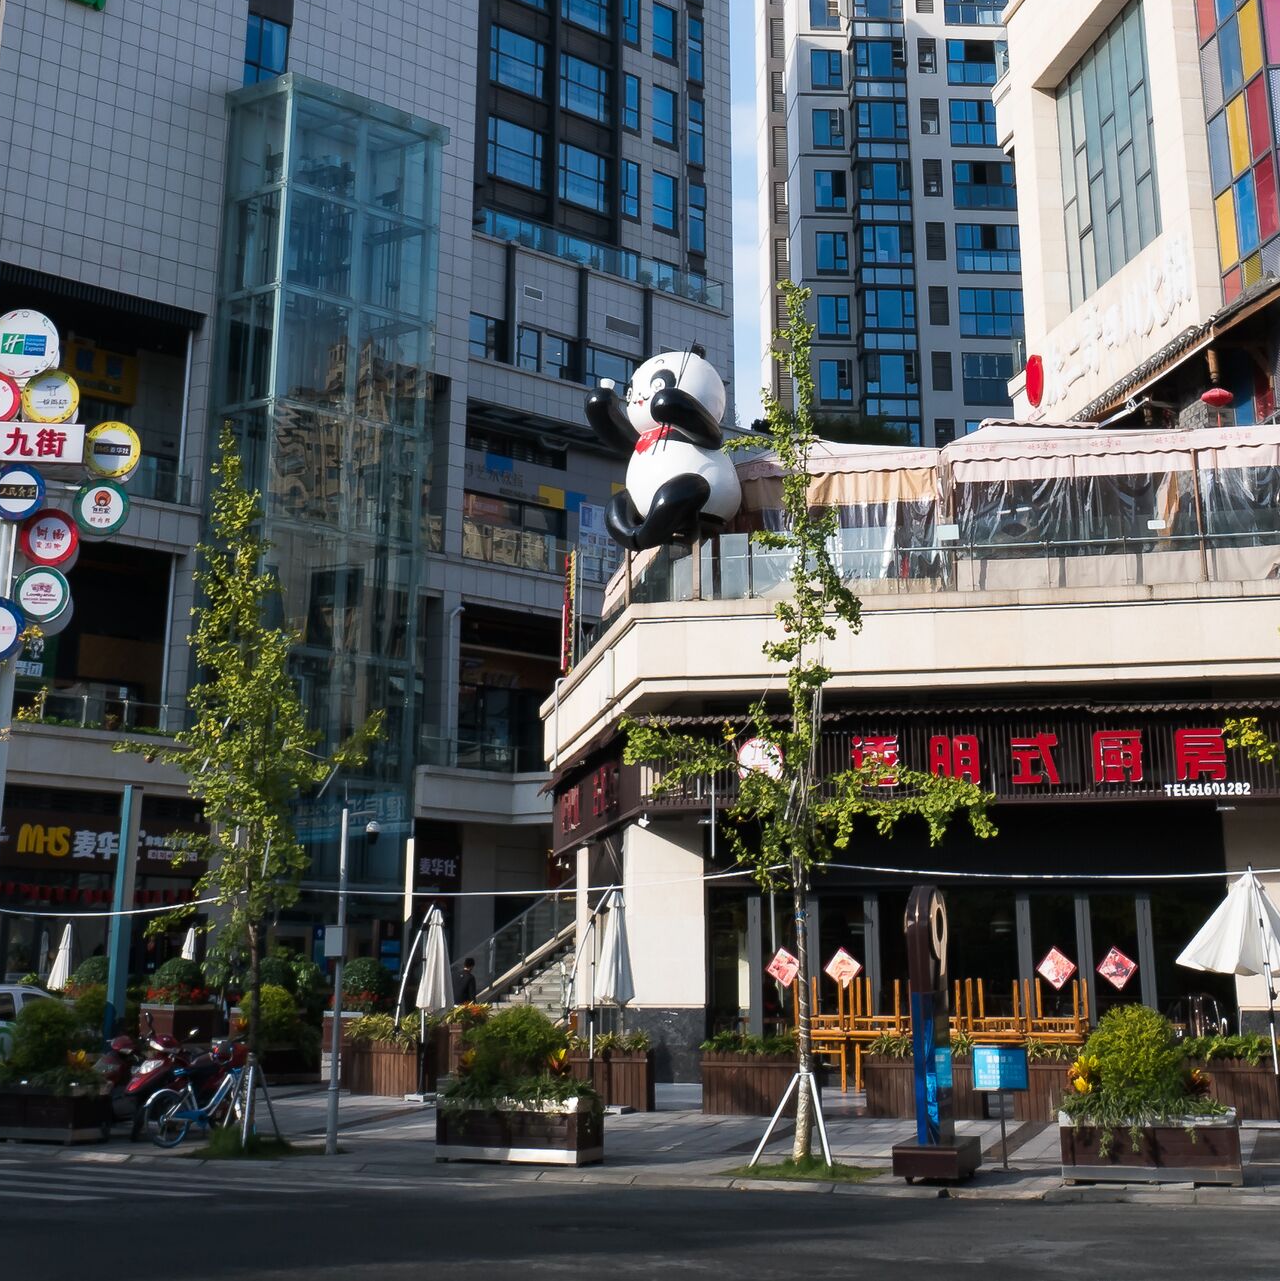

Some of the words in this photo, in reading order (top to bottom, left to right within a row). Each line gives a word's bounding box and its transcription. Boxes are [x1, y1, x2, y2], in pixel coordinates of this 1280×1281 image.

[3, 426, 68, 458] 九街
[16, 823, 71, 857] MHS
[418, 857, 457, 877] 麦华仕
